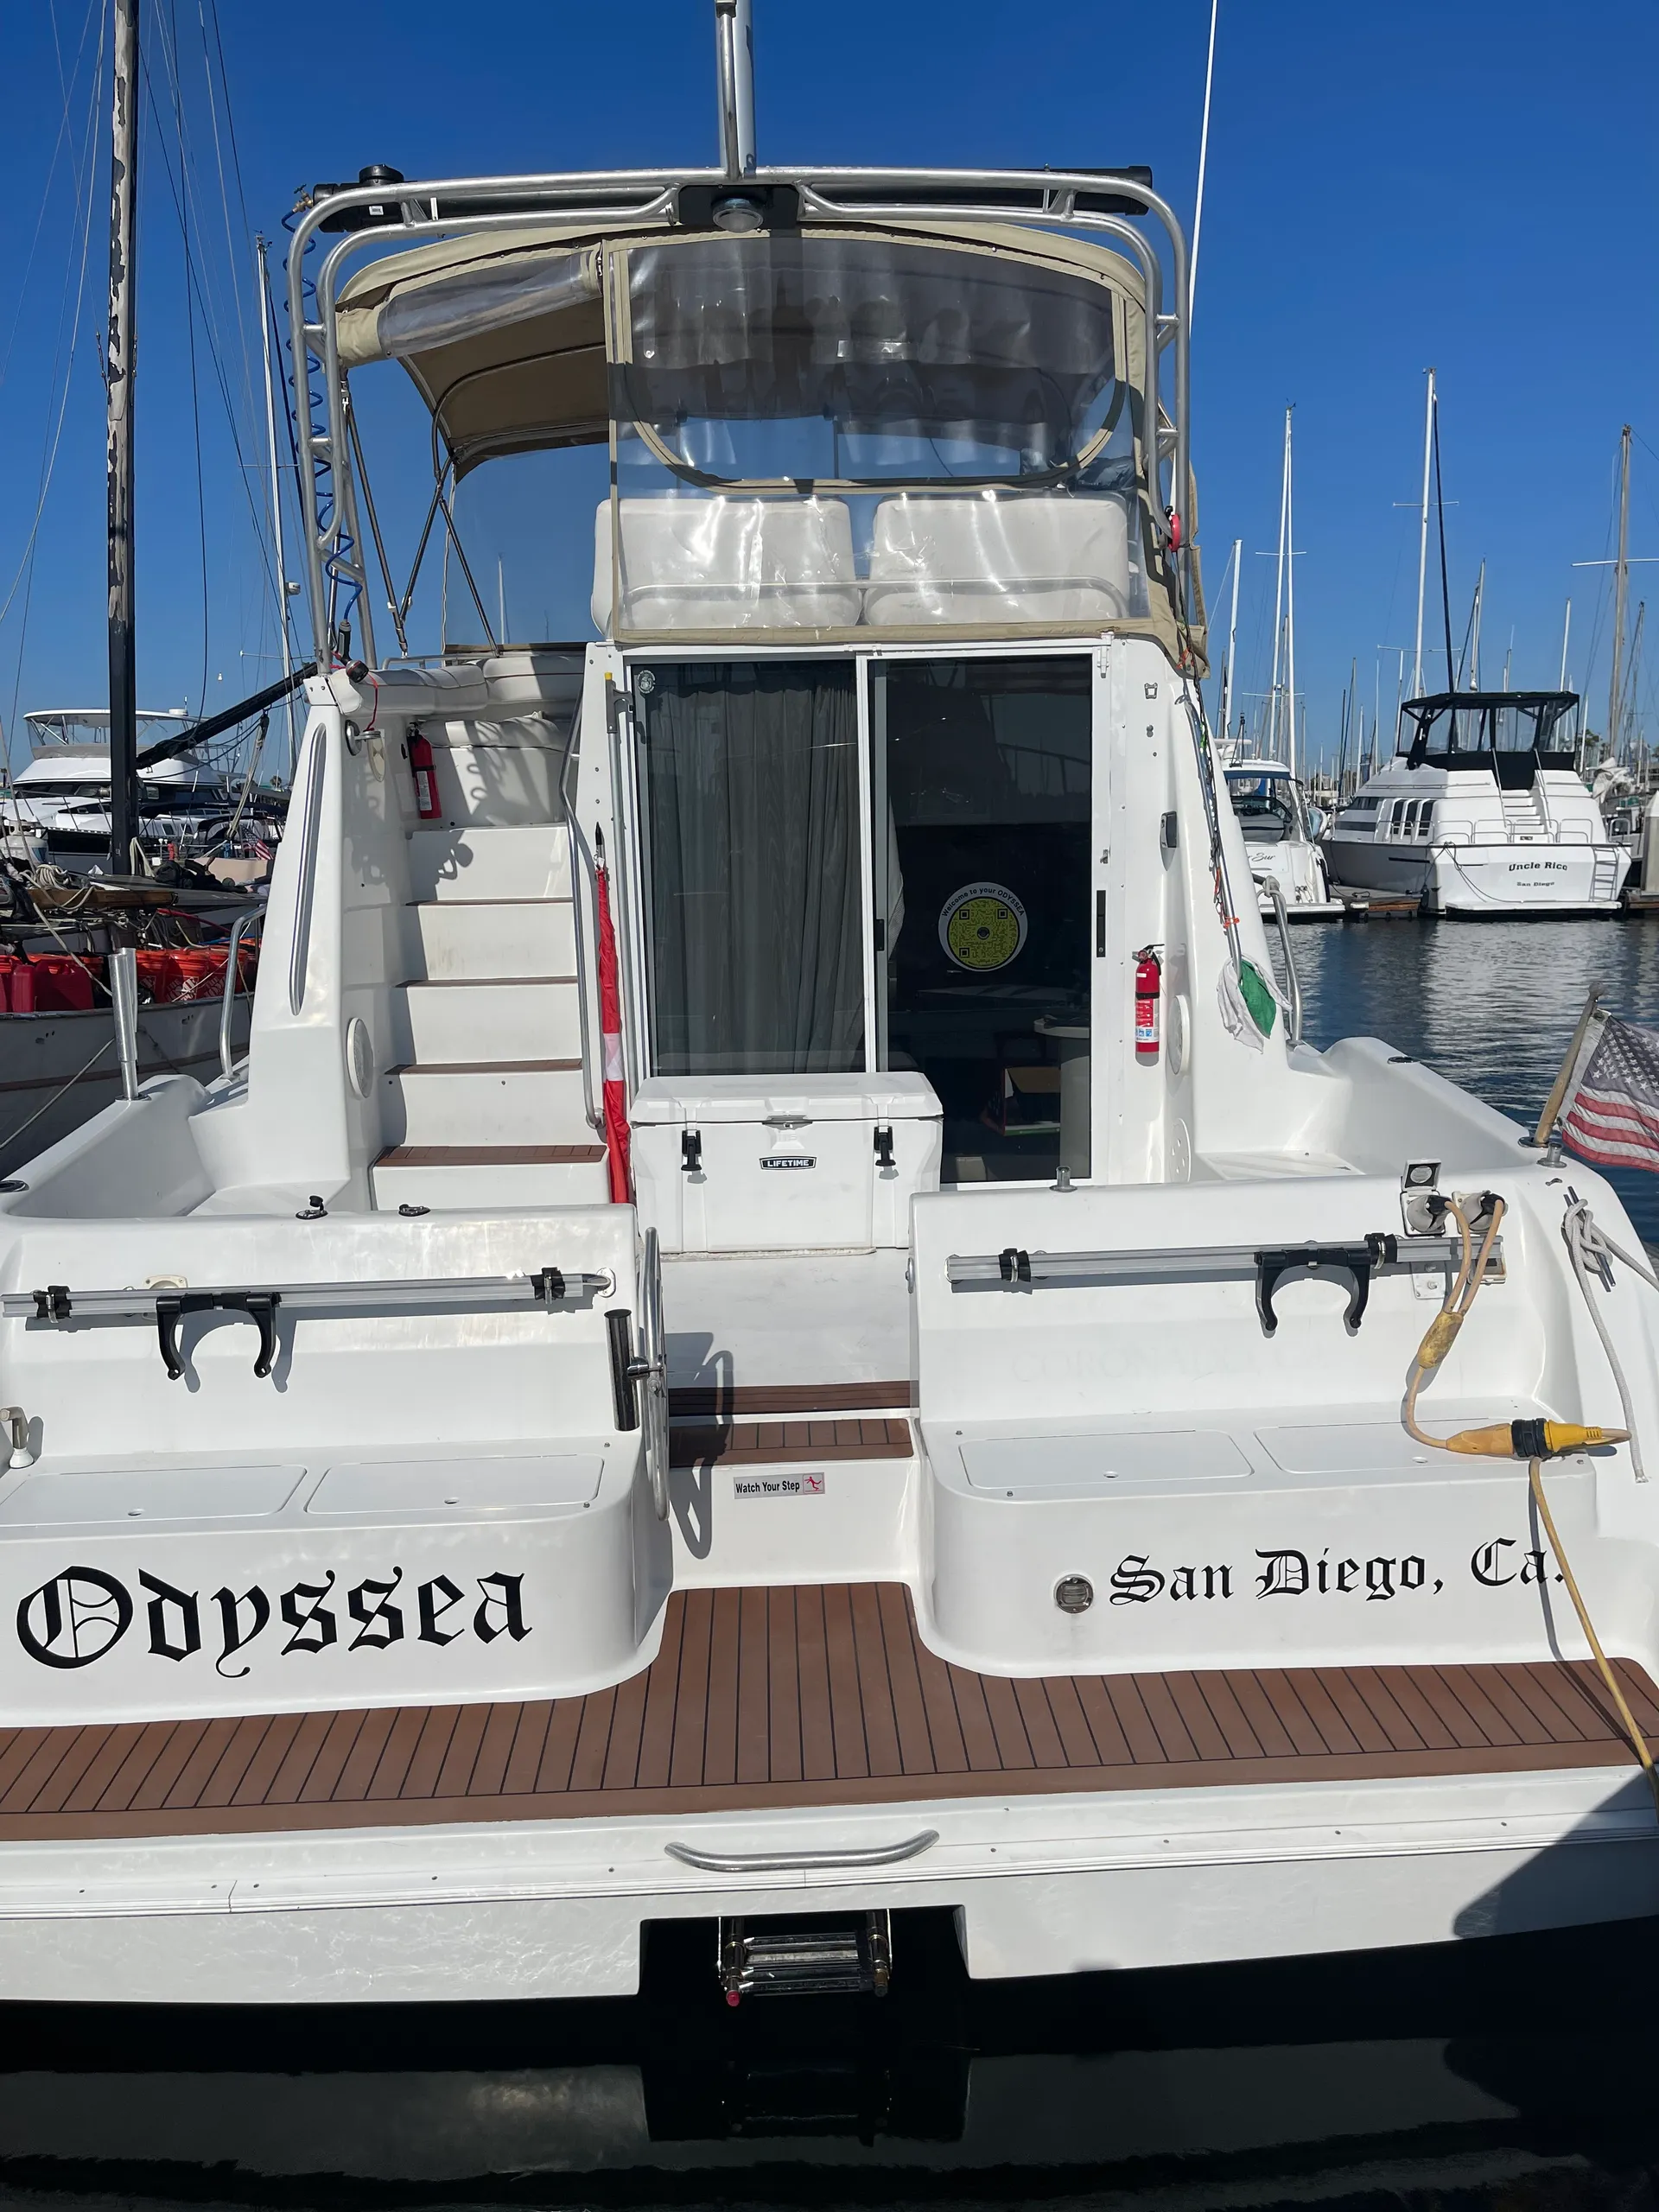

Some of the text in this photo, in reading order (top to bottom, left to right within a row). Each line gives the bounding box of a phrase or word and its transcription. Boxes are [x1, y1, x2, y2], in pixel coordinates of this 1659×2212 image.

[1509, 861, 1567, 871] Uncle Rico
[942, 892, 969, 917] Welcome
[997, 890, 1025, 917] ODYSSEA
[735, 1480, 800, 1493] Watch Your Step
[1109, 1537, 1565, 1605] San Diego, Ca.
[16, 1565, 533, 1678] Odyssea
